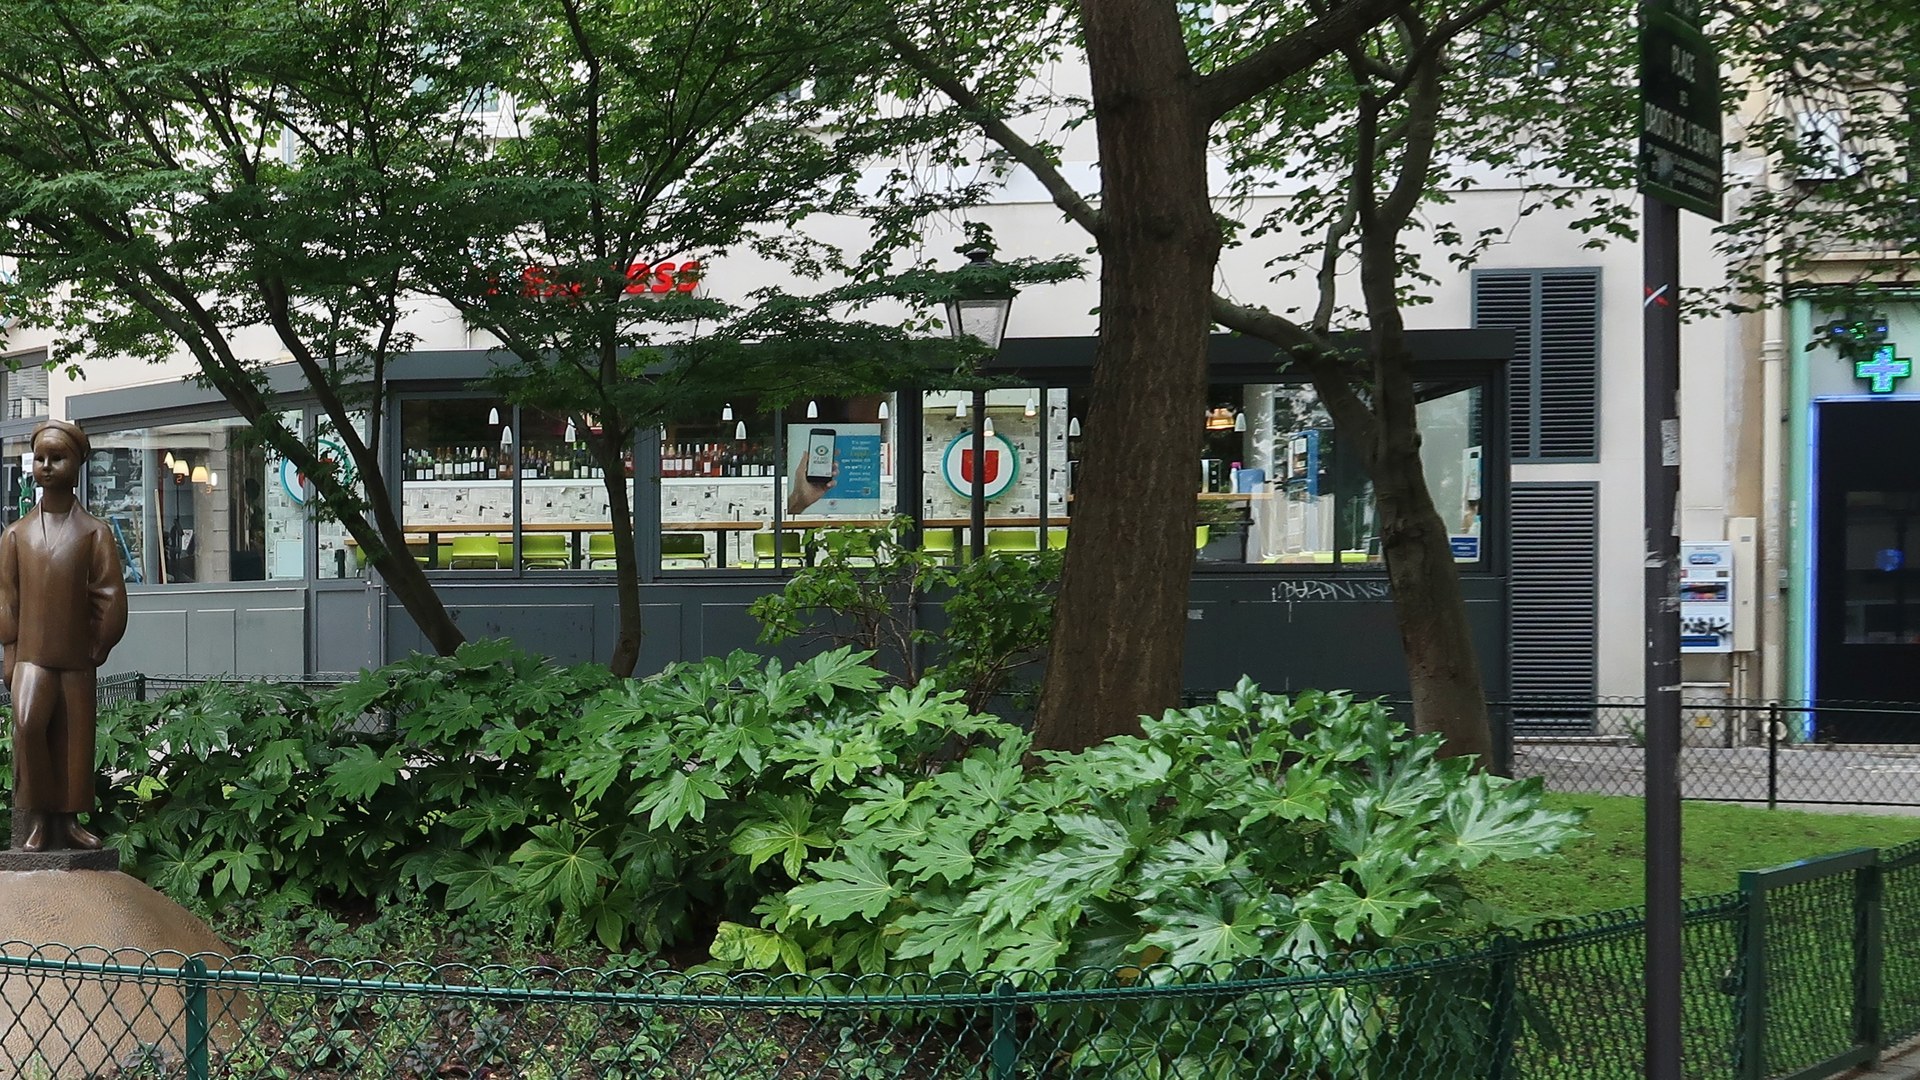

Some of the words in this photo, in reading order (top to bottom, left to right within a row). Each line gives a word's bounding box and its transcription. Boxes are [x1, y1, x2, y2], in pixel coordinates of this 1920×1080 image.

[1671, 43, 1697, 84] PLACE
[1644, 101, 1673, 141] DROITS
[1674, 115, 1686, 147] DE
[961, 449, 999, 484] U
